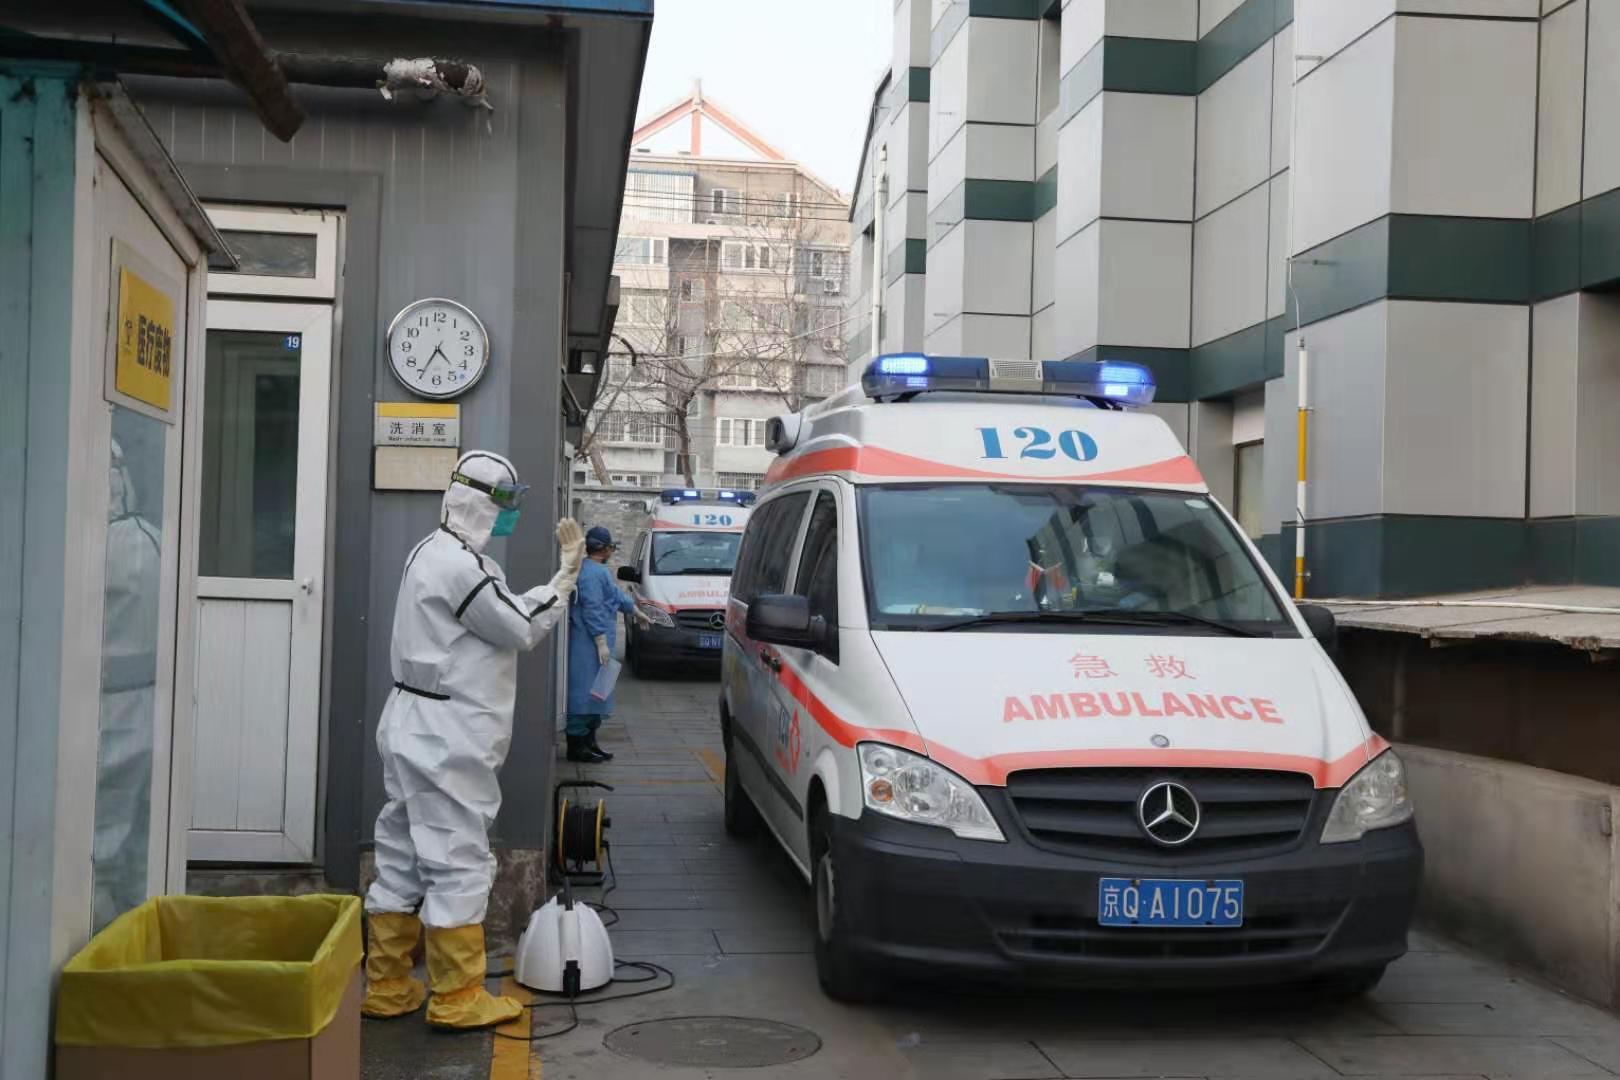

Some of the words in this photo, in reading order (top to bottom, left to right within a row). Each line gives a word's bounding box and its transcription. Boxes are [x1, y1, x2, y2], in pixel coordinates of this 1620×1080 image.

[419, 316, 429, 327] 11
[434, 311, 447, 323] 12
[407, 327, 420, 338] 10
[460, 330, 470, 341] 2
[287, 335, 300, 349] 19
[401, 341, 412, 352] 9
[464, 345, 474, 356] 3
[406, 356, 417, 367] 8
[456, 360, 467, 370] 4
[416, 368, 425, 380] 7
[447, 370, 457, 382] 5
[431, 375, 442, 386] 6
[390, 421, 449, 435] 洗消室
[976, 426, 1098, 462] 120
[693, 513, 733, 527] 120
[1069, 652, 1197, 680] 急救
[1002, 691, 1285, 725] AMBULANCE
